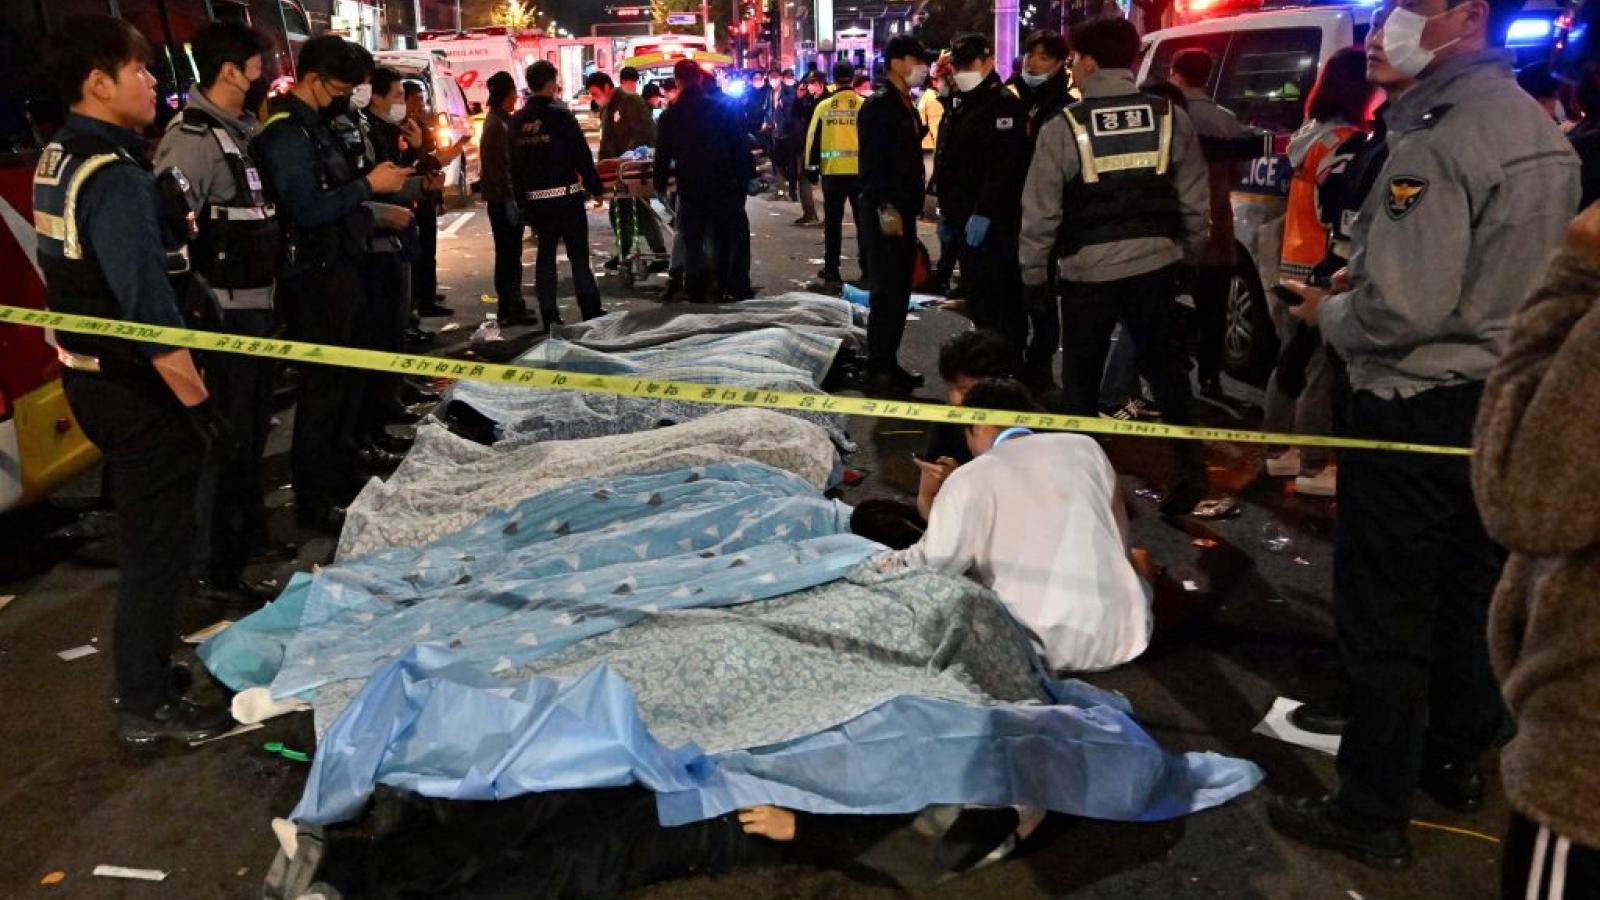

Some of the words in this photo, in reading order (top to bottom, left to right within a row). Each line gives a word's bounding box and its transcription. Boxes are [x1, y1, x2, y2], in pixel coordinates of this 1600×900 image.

[447, 48, 489, 57] MBULANCE
[1102, 110, 1142, 130] 경찰
[1241, 157, 1279, 186] ICE
